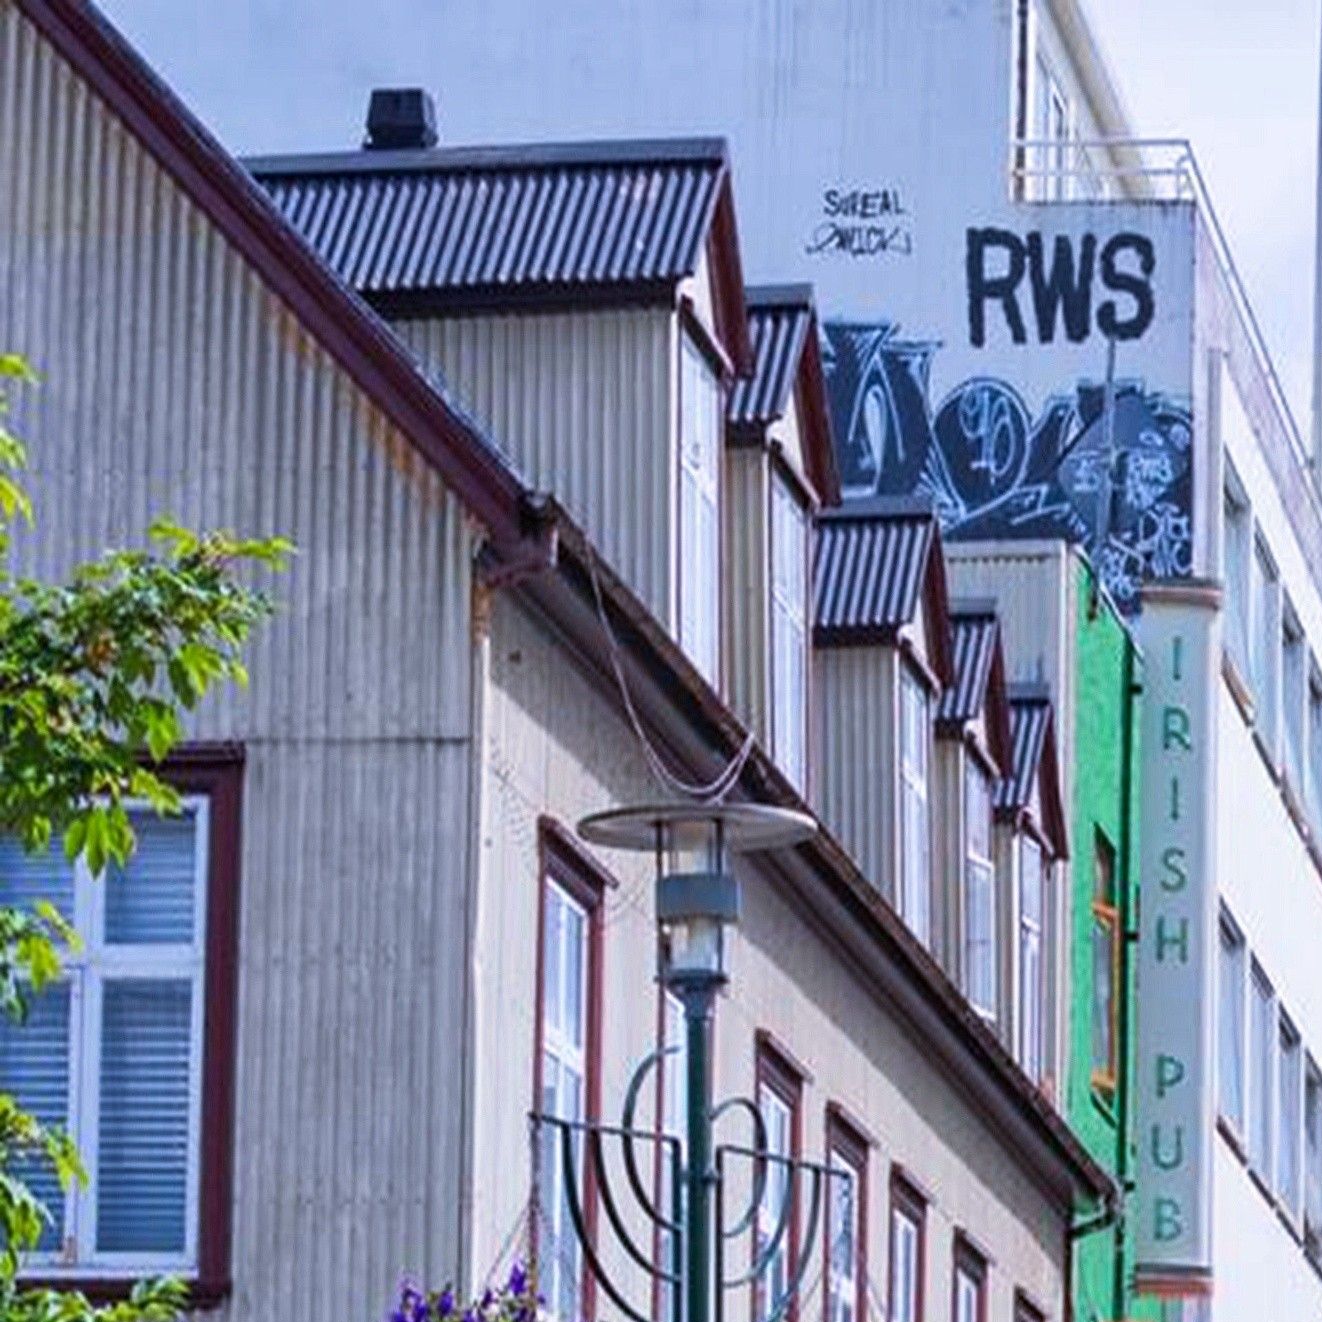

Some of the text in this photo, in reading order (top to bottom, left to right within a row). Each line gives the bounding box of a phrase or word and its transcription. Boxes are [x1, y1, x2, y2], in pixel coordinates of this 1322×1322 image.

[965, 226, 1156, 348] RWS
[1151, 636, 1192, 1242] IRISH PUB
